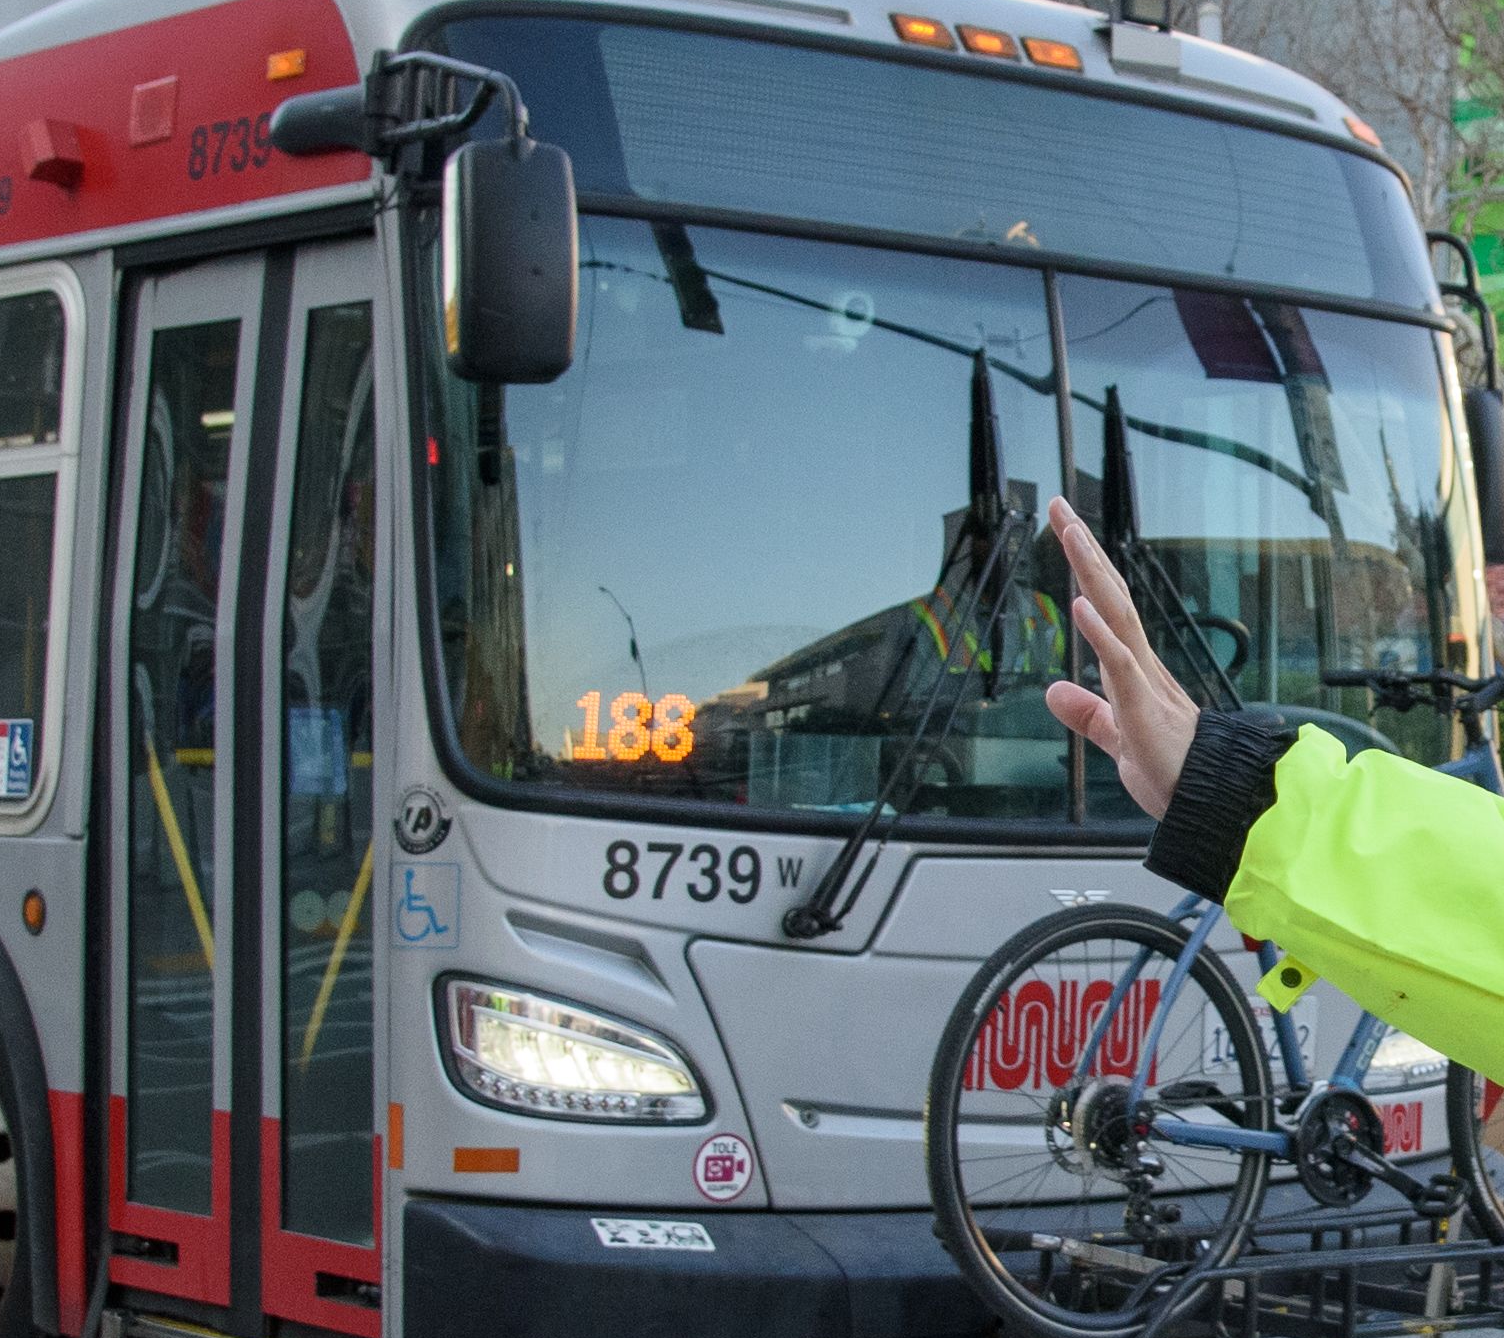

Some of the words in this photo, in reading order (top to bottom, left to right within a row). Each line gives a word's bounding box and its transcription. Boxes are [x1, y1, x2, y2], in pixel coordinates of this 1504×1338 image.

[187, 111, 273, 182] 8739
[573, 690, 696, 762] 188
[603, 839, 763, 905] 8739
[776, 856, 804, 888] W
[711, 1142, 739, 1155] TOLE
